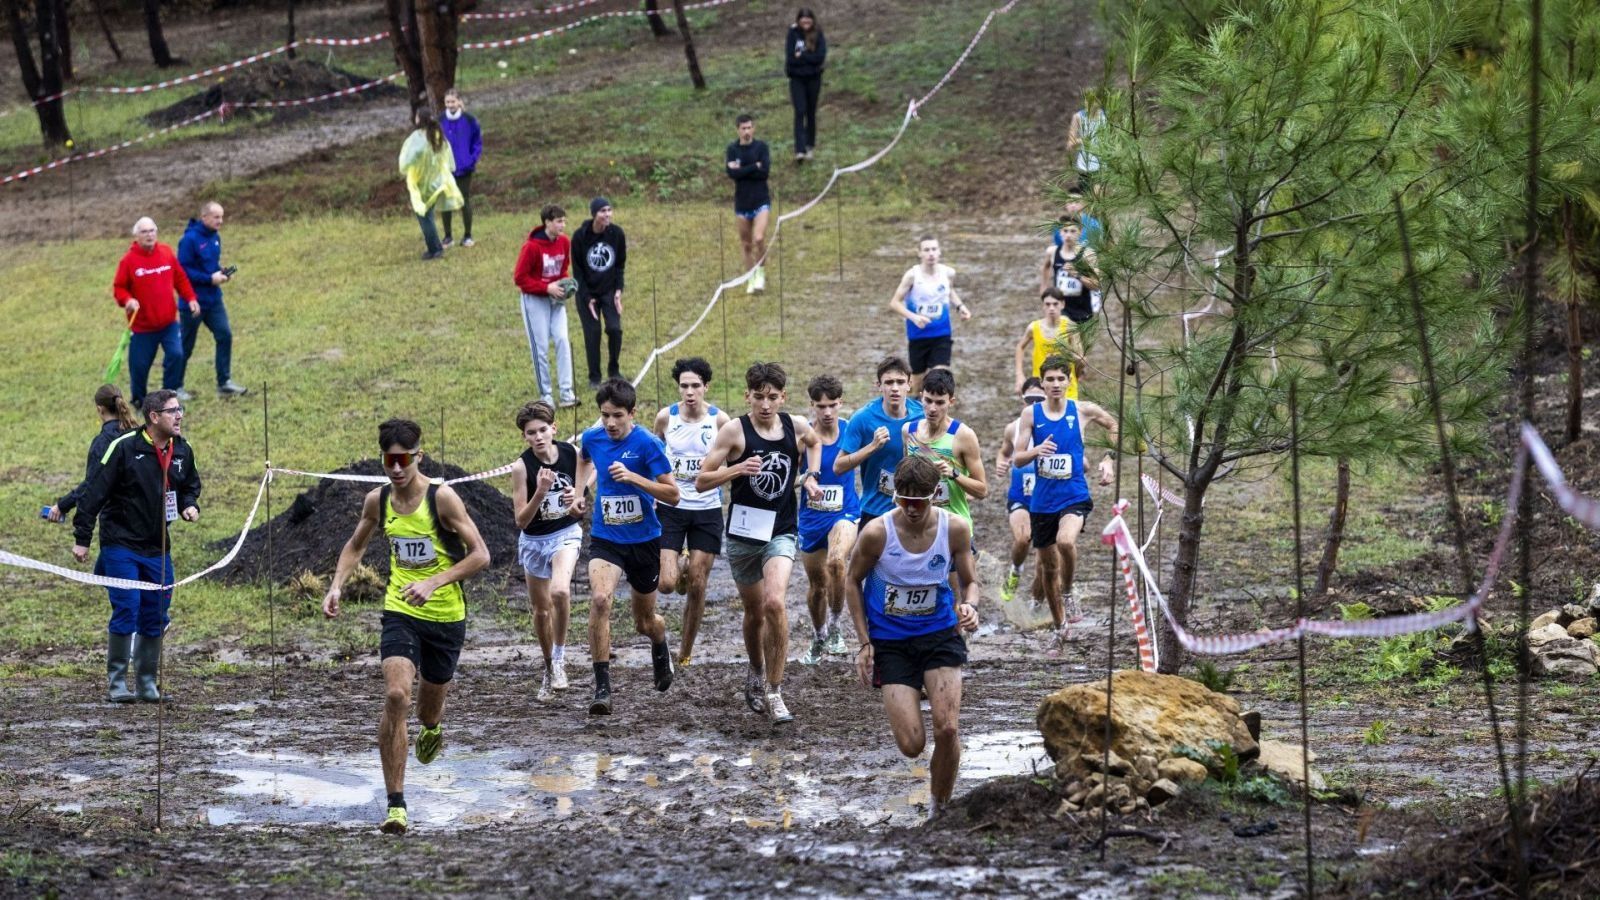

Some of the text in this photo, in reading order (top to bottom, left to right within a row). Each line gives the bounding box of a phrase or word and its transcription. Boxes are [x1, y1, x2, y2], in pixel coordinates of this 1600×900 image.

[686, 459, 702, 471] 139
[1049, 458, 1066, 470] 102
[822, 489, 837, 502] 101
[615, 500, 634, 514] 210
[405, 542, 427, 557] 172
[906, 589, 929, 605] 157
